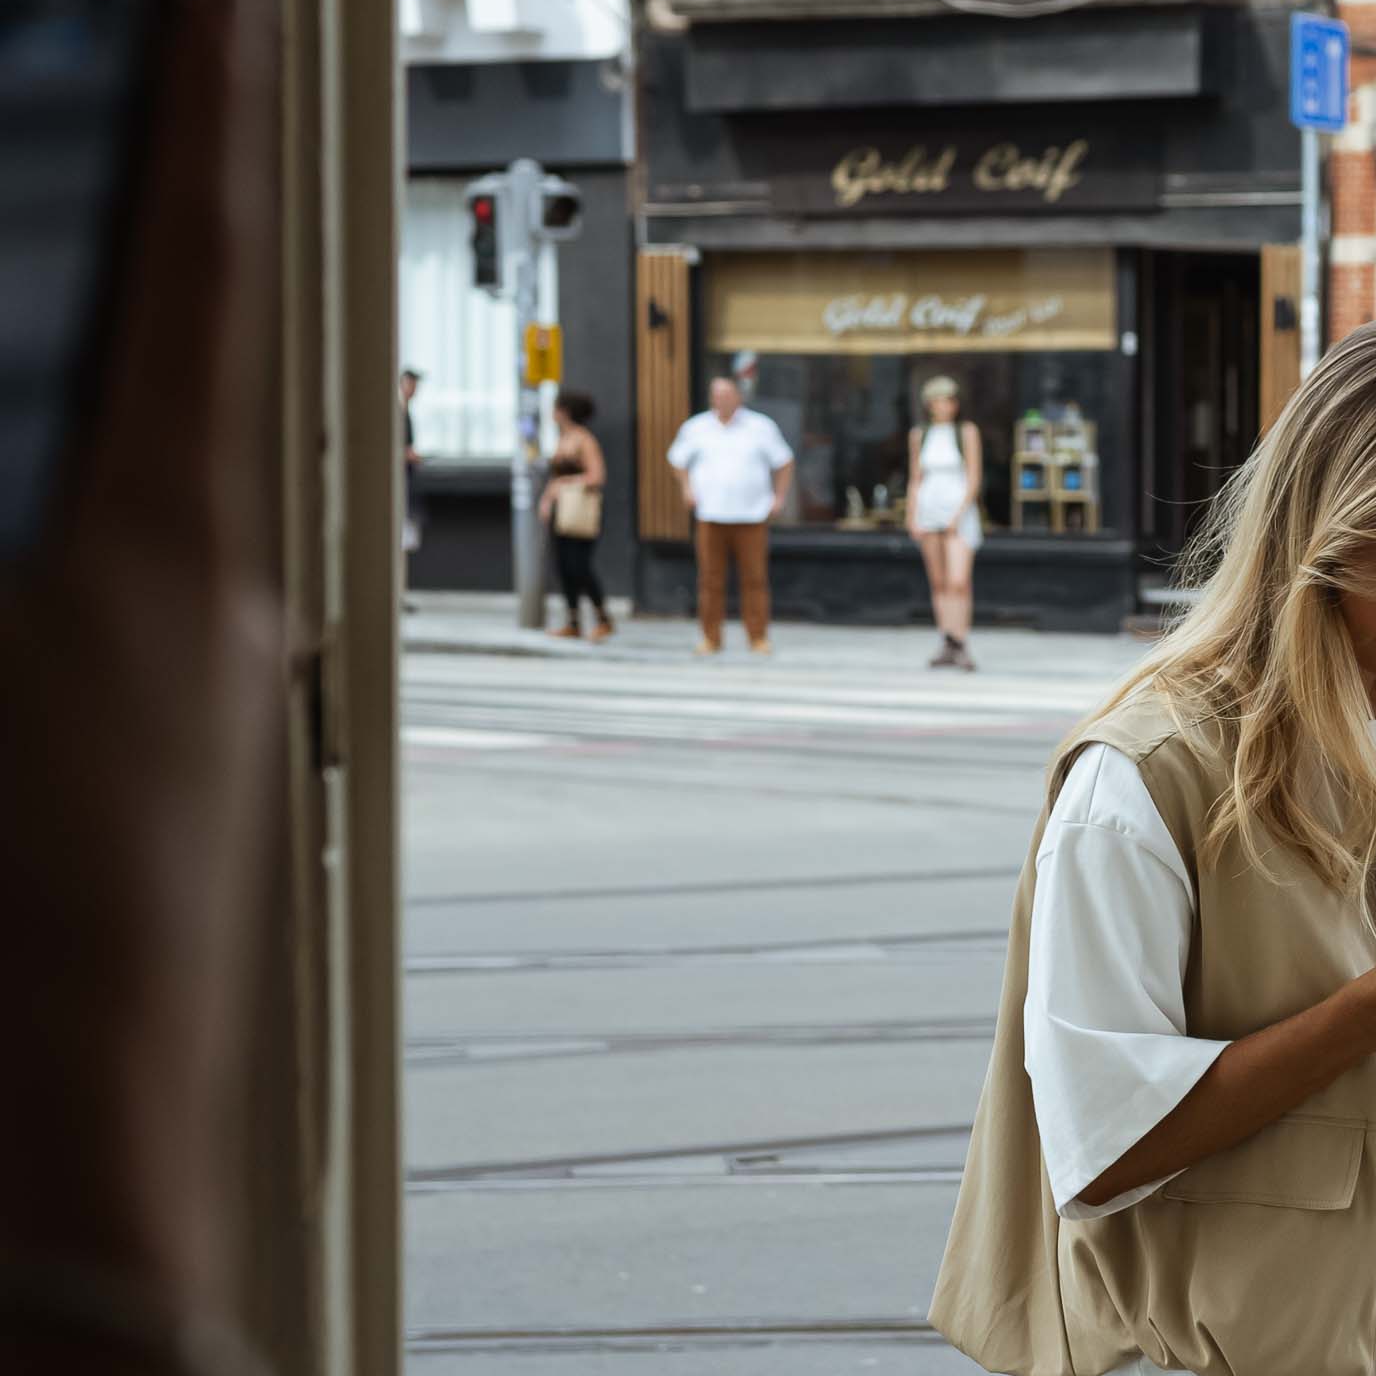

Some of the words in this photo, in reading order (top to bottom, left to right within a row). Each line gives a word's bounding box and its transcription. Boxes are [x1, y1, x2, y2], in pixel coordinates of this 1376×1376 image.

[830, 145, 957, 207] Gold
[972, 138, 1089, 203] Coif
[822, 291, 908, 336] Gold
[909, 291, 987, 335] Coif
